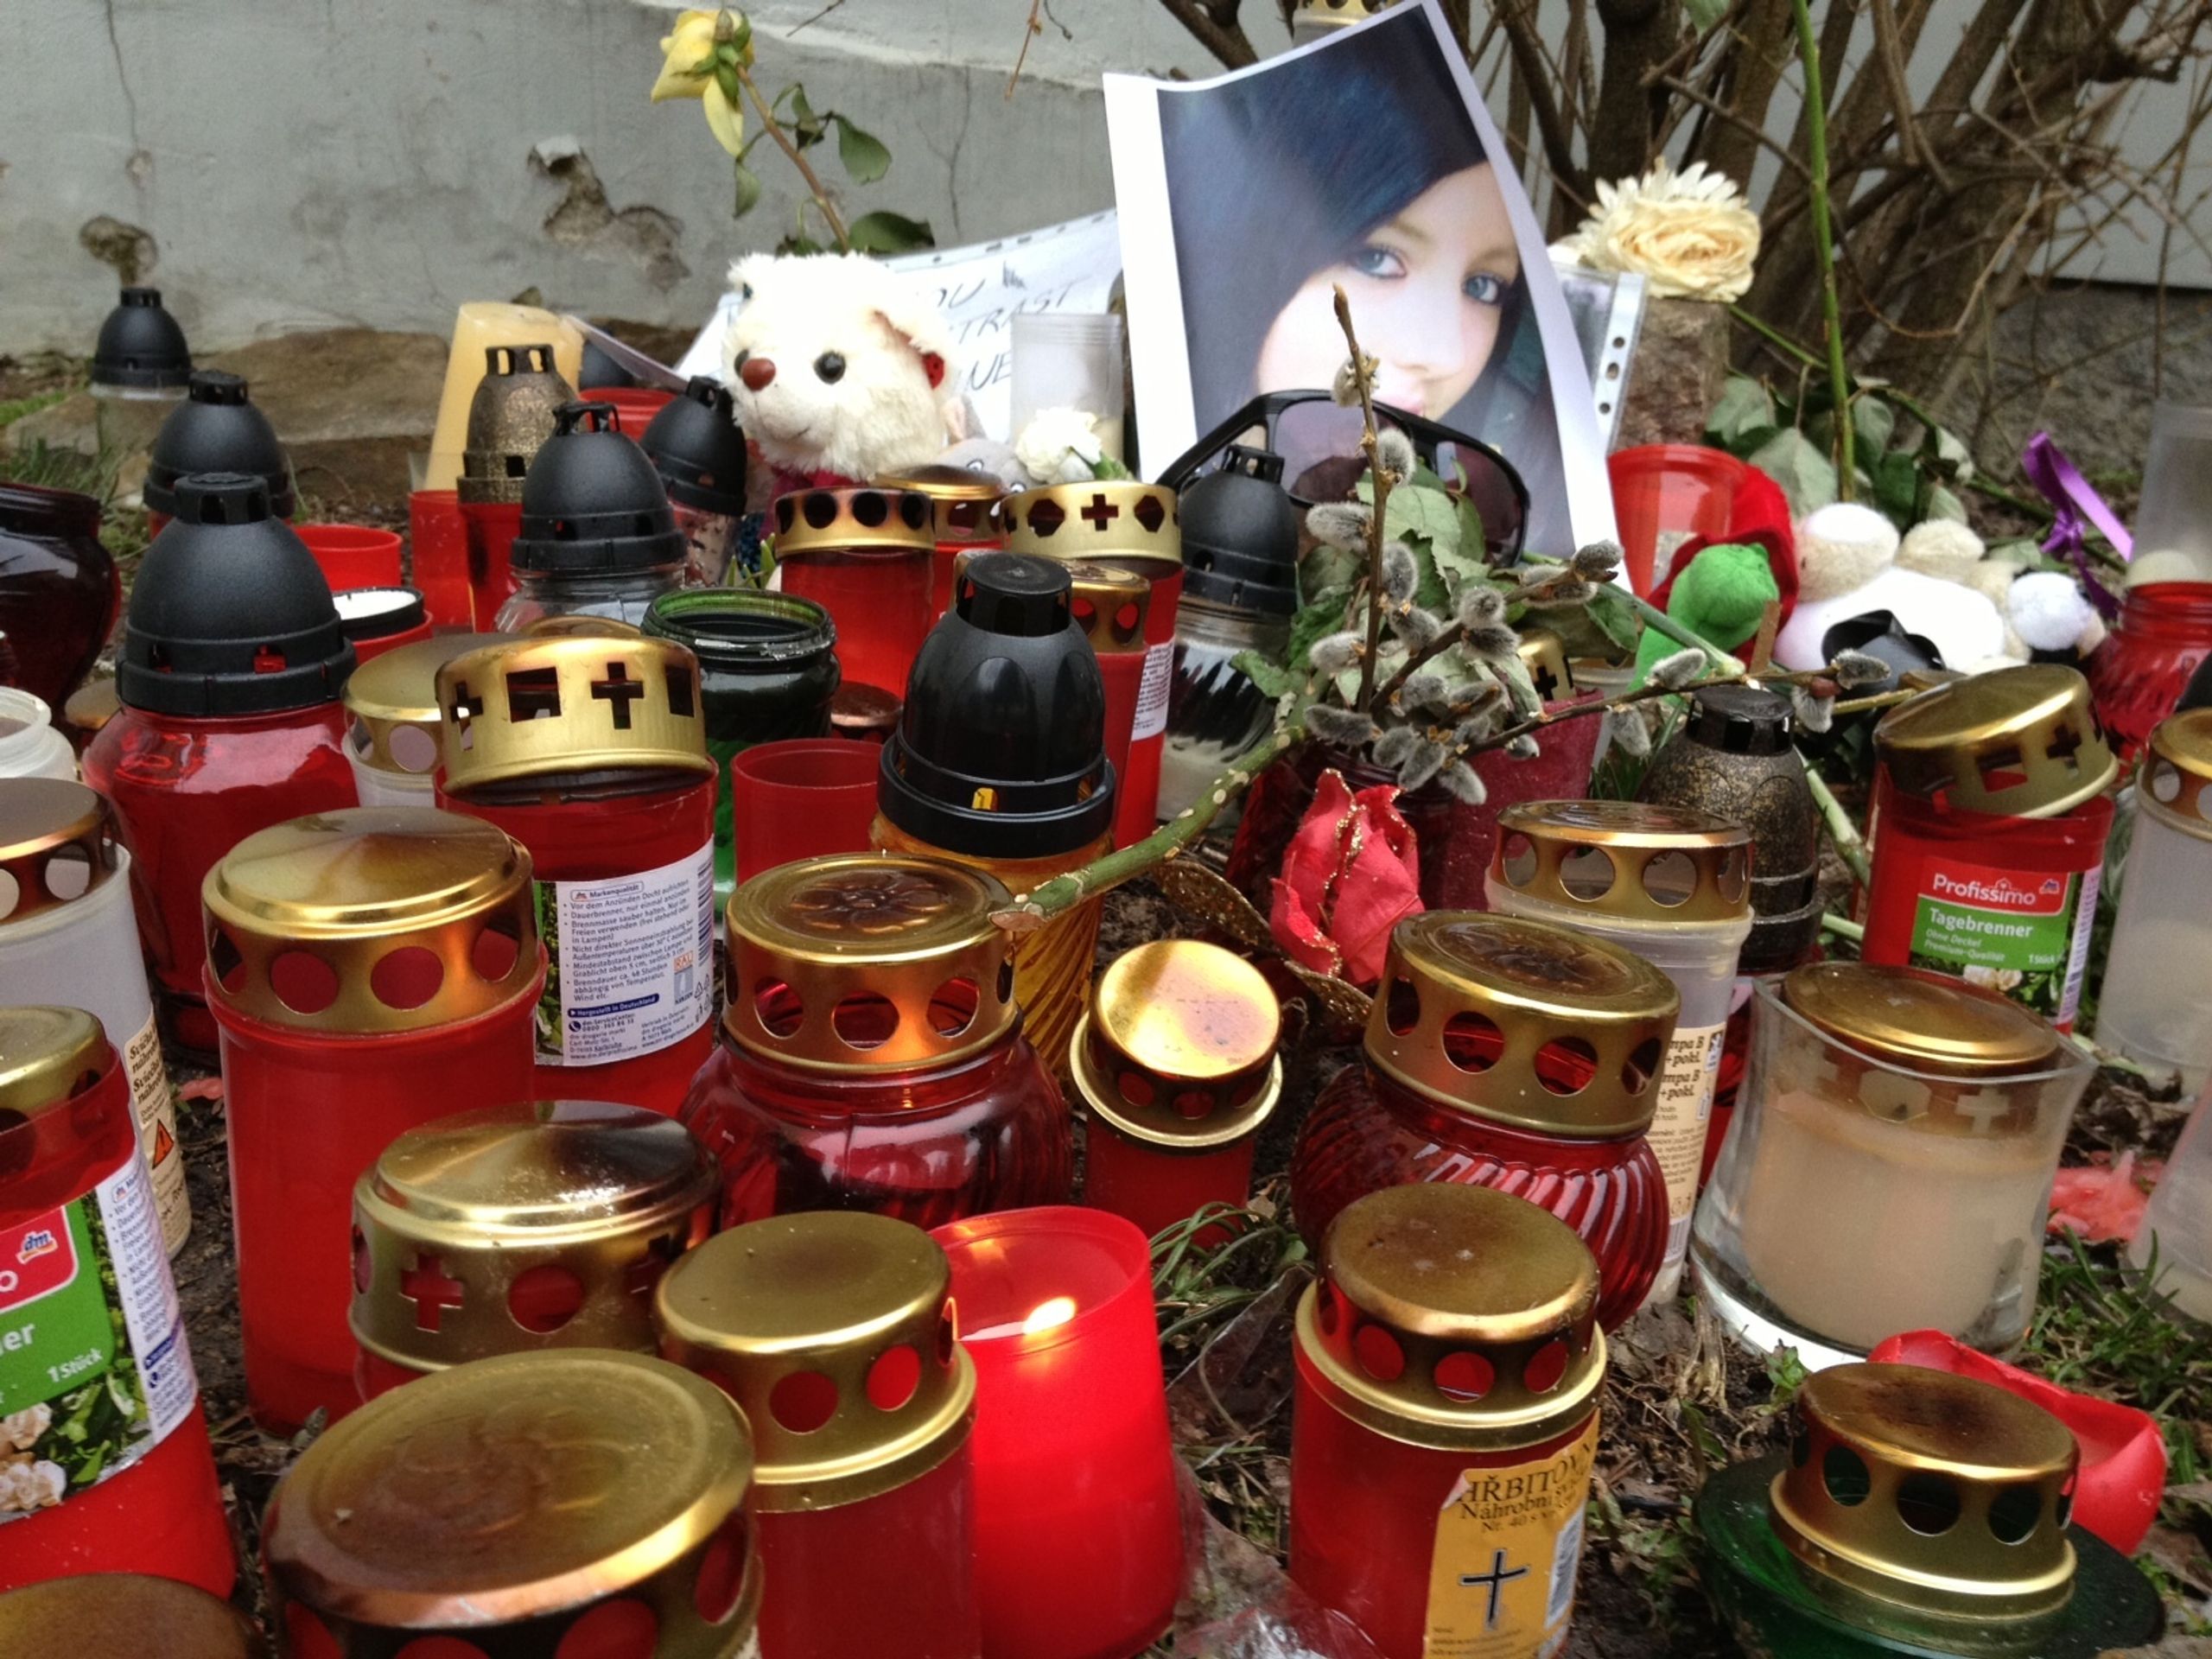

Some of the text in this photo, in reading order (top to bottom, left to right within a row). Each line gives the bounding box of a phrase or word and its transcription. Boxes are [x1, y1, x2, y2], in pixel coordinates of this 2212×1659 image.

[1933, 873, 2036, 906] Profissimo
[1929, 907, 2033, 938] Tagebrenner
[0, 1322, 35, 1357] er
